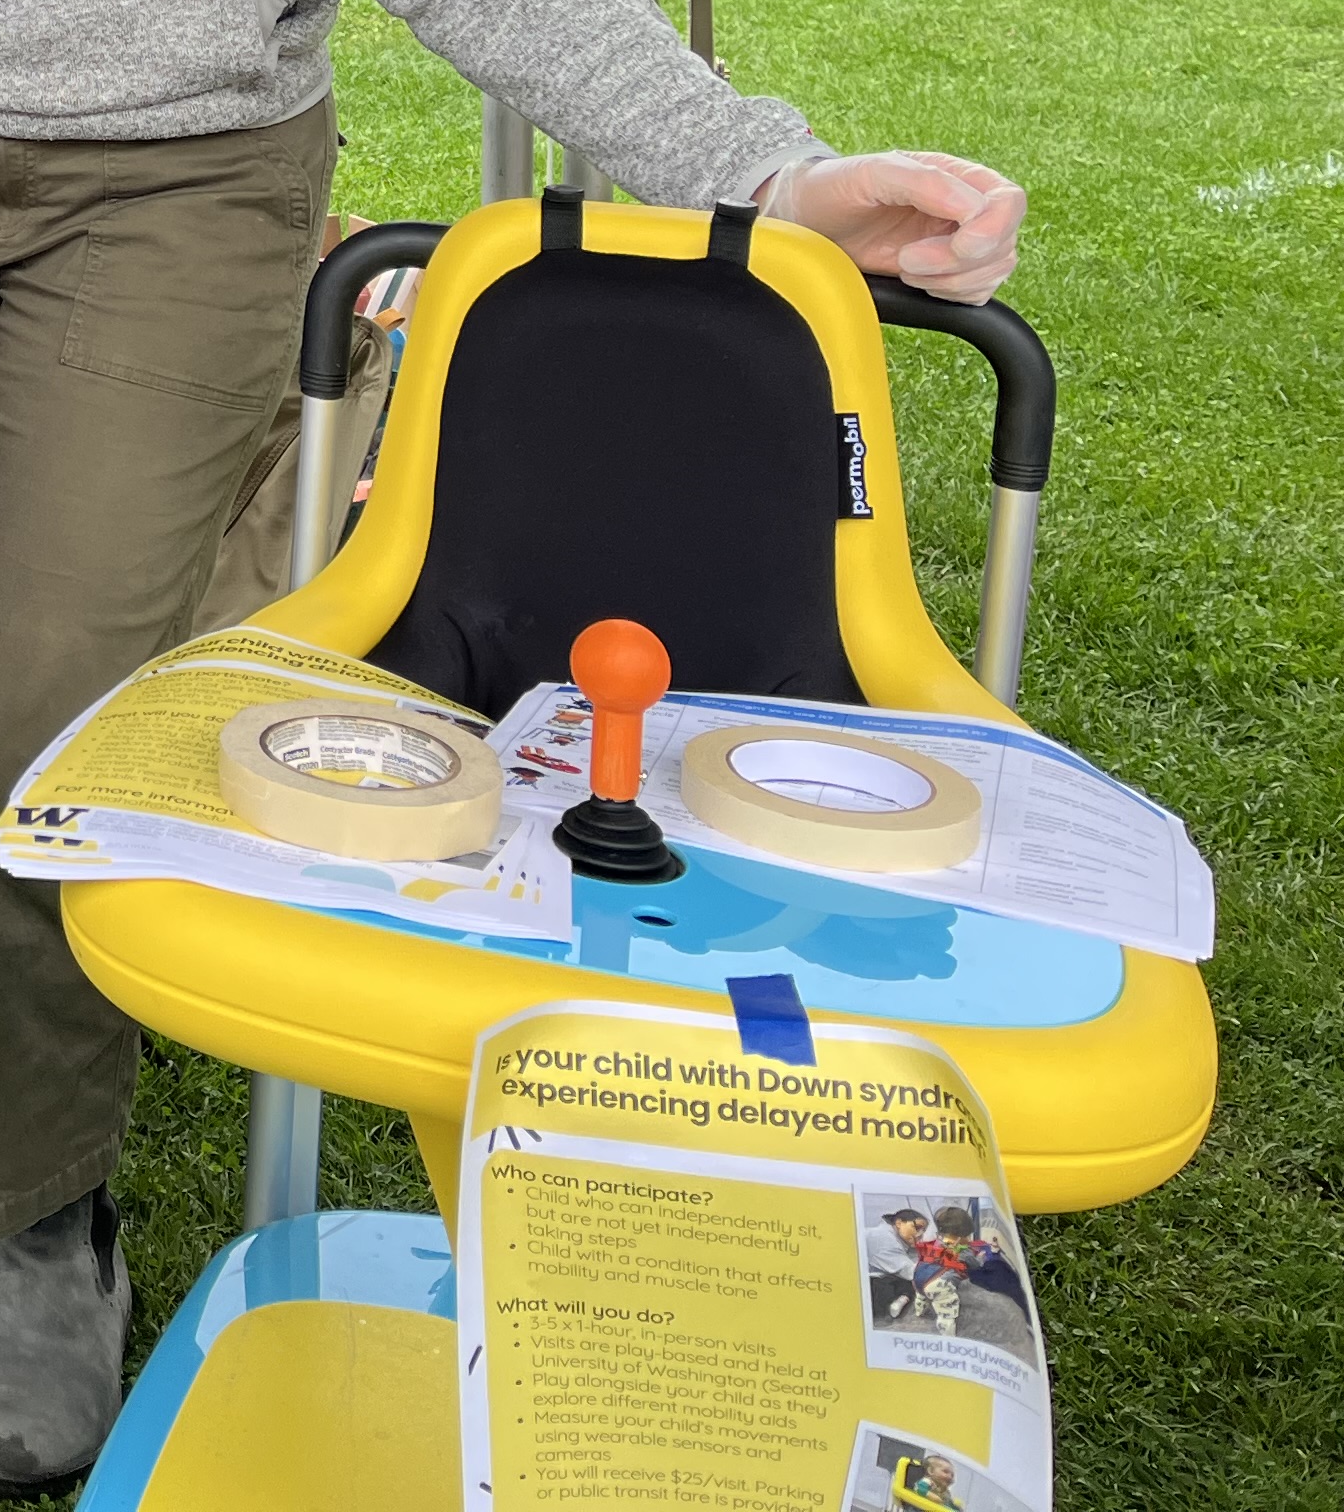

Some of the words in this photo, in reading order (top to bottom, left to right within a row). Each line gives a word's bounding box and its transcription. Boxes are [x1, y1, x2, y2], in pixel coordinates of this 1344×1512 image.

[842, 417, 871, 514] permobil
[14, 807, 90, 828] W
[496, 1053, 512, 1075] Is
[516, 1048, 588, 1075] your
[593, 1051, 673, 1082] child
[679, 1060, 751, 1089] with
[758, 1067, 853, 1100] Down
[501, 1078, 711, 1128] experiencing
[717, 1098, 854, 1138] delayed
[491, 1164, 537, 1182] Who
[541, 1173, 579, 1189] can
[585, 1178, 714, 1206] participate?
[525, 1186, 570, 1206] Child
[575, 1195, 614, 1211] who
[619, 1201, 653, 1215] can
[657, 1204, 793, 1238] independently
[526, 1203, 556, 1222] but
[560, 1212, 592, 1227] are
[597, 1216, 627, 1231] not
[631, 1221, 661, 1237] yet
[666, 1223, 801, 1257] independently
[527, 1222, 583, 1246] taking
[588, 1232, 638, 1249] steps
[527, 1240, 571, 1259] Child
[576, 1249, 613, 1263] with
[618, 1254, 630, 1266] a
[635, 1256, 720, 1277] condition
[724, 1266, 764, 1284] that
[767, 1273, 833, 1294] affects
[528, 1260, 599, 1282] mobility
[604, 1270, 640, 1284] and
[645, 1274, 711, 1294] muscle
[716, 1282, 758, 1300] tone
[496, 1297, 549, 1315] What
[554, 1300, 586, 1316] will
[592, 1305, 631, 1321] you
[636, 1309, 675, 1326] do?
[530, 1316, 558, 1331] 3-5
[562, 1320, 573, 1332] x
[577, 1319, 637, 1341] 1-hour,
[640, 1327, 727, 1350] in-person
[732, 1340, 777, 1358] visits
[530, 1336, 575, 1350] Visits
[579, 1340, 611, 1353] are
[615, 1342, 719, 1367] play-based
[723, 1358, 760, 1372] and
[764, 1360, 804, 1378] held
[808, 1368, 828, 1381] at
[531, 1354, 618, 1375] University
[623, 1361, 643, 1374] of
[647, 1364, 757, 1389] Washington
[762, 1379, 840, 1403] (Seattle)
[532, 1373, 570, 1389] Play
[574, 1373, 662, 1393] alongside
[666, 1385, 708, 1399] your
[712, 1390, 755, 1407] child
[759, 1397, 782, 1410] as
[786, 1399, 827, 1419] they
[533, 1391, 598, 1407] explore
[601, 1394, 678, 1414] different
[682, 1404, 755, 1426] mobility
[759, 1415, 798, 1430] aids
[534, 1411, 609, 1425] Measure
[614, 1414, 655, 1428] your
[659, 1418, 714, 1435] child's
[718, 1426, 828, 1451] movements
[534, 1429, 580, 1445] using
[584, 1431, 668, 1447] wearable
[672, 1438, 742, 1456] sensors
[745, 1447, 782, 1462] and
[535, 1449, 612, 1462] cameras
[536, 1467, 568, 1480] You
[572, 1465, 599, 1479] will
[603, 1468, 666, 1482] receive
[755, 1480, 825, 1505] Parking
[536, 1488, 552, 1500] or
[559, 1483, 610, 1501] public
[614, 1485, 669, 1500] transit
[675, 1488, 711, 1503] fare
[715, 1493, 728, 1506] is
